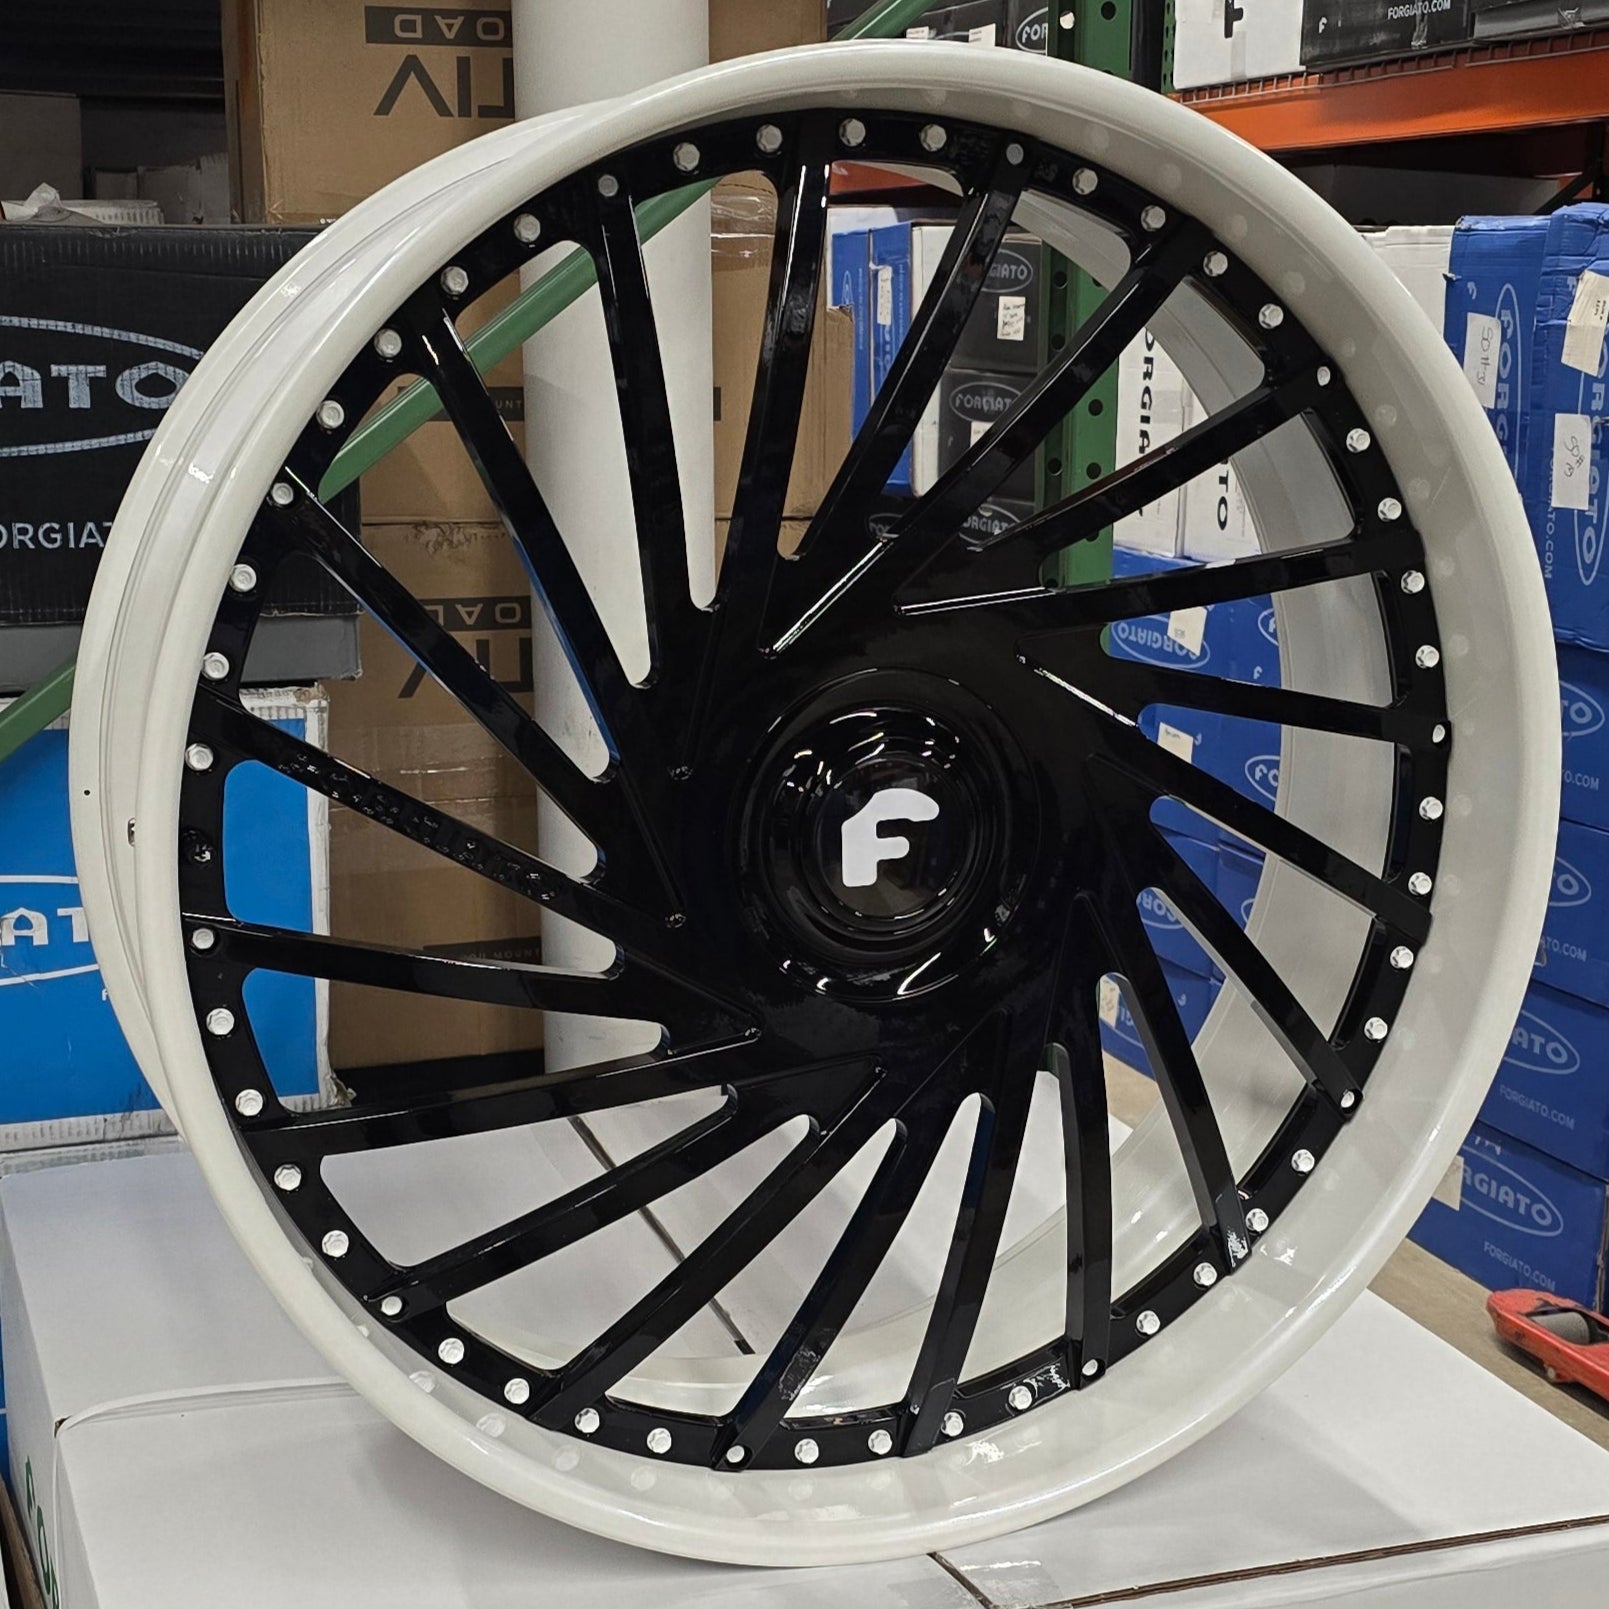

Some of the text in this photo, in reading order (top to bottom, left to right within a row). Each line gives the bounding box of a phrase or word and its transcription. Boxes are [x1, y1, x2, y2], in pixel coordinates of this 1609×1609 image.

[1388, 0, 1451, 20] FORGIATO.COM
[0, 522, 113, 550] RGIA
[1562, 768, 1599, 791] O.COM
[841, 788, 940, 887] F
[1500, 1084, 1576, 1130] FORGIATO.COM
[1484, 1241, 1557, 1292] FORGIATO.COM
